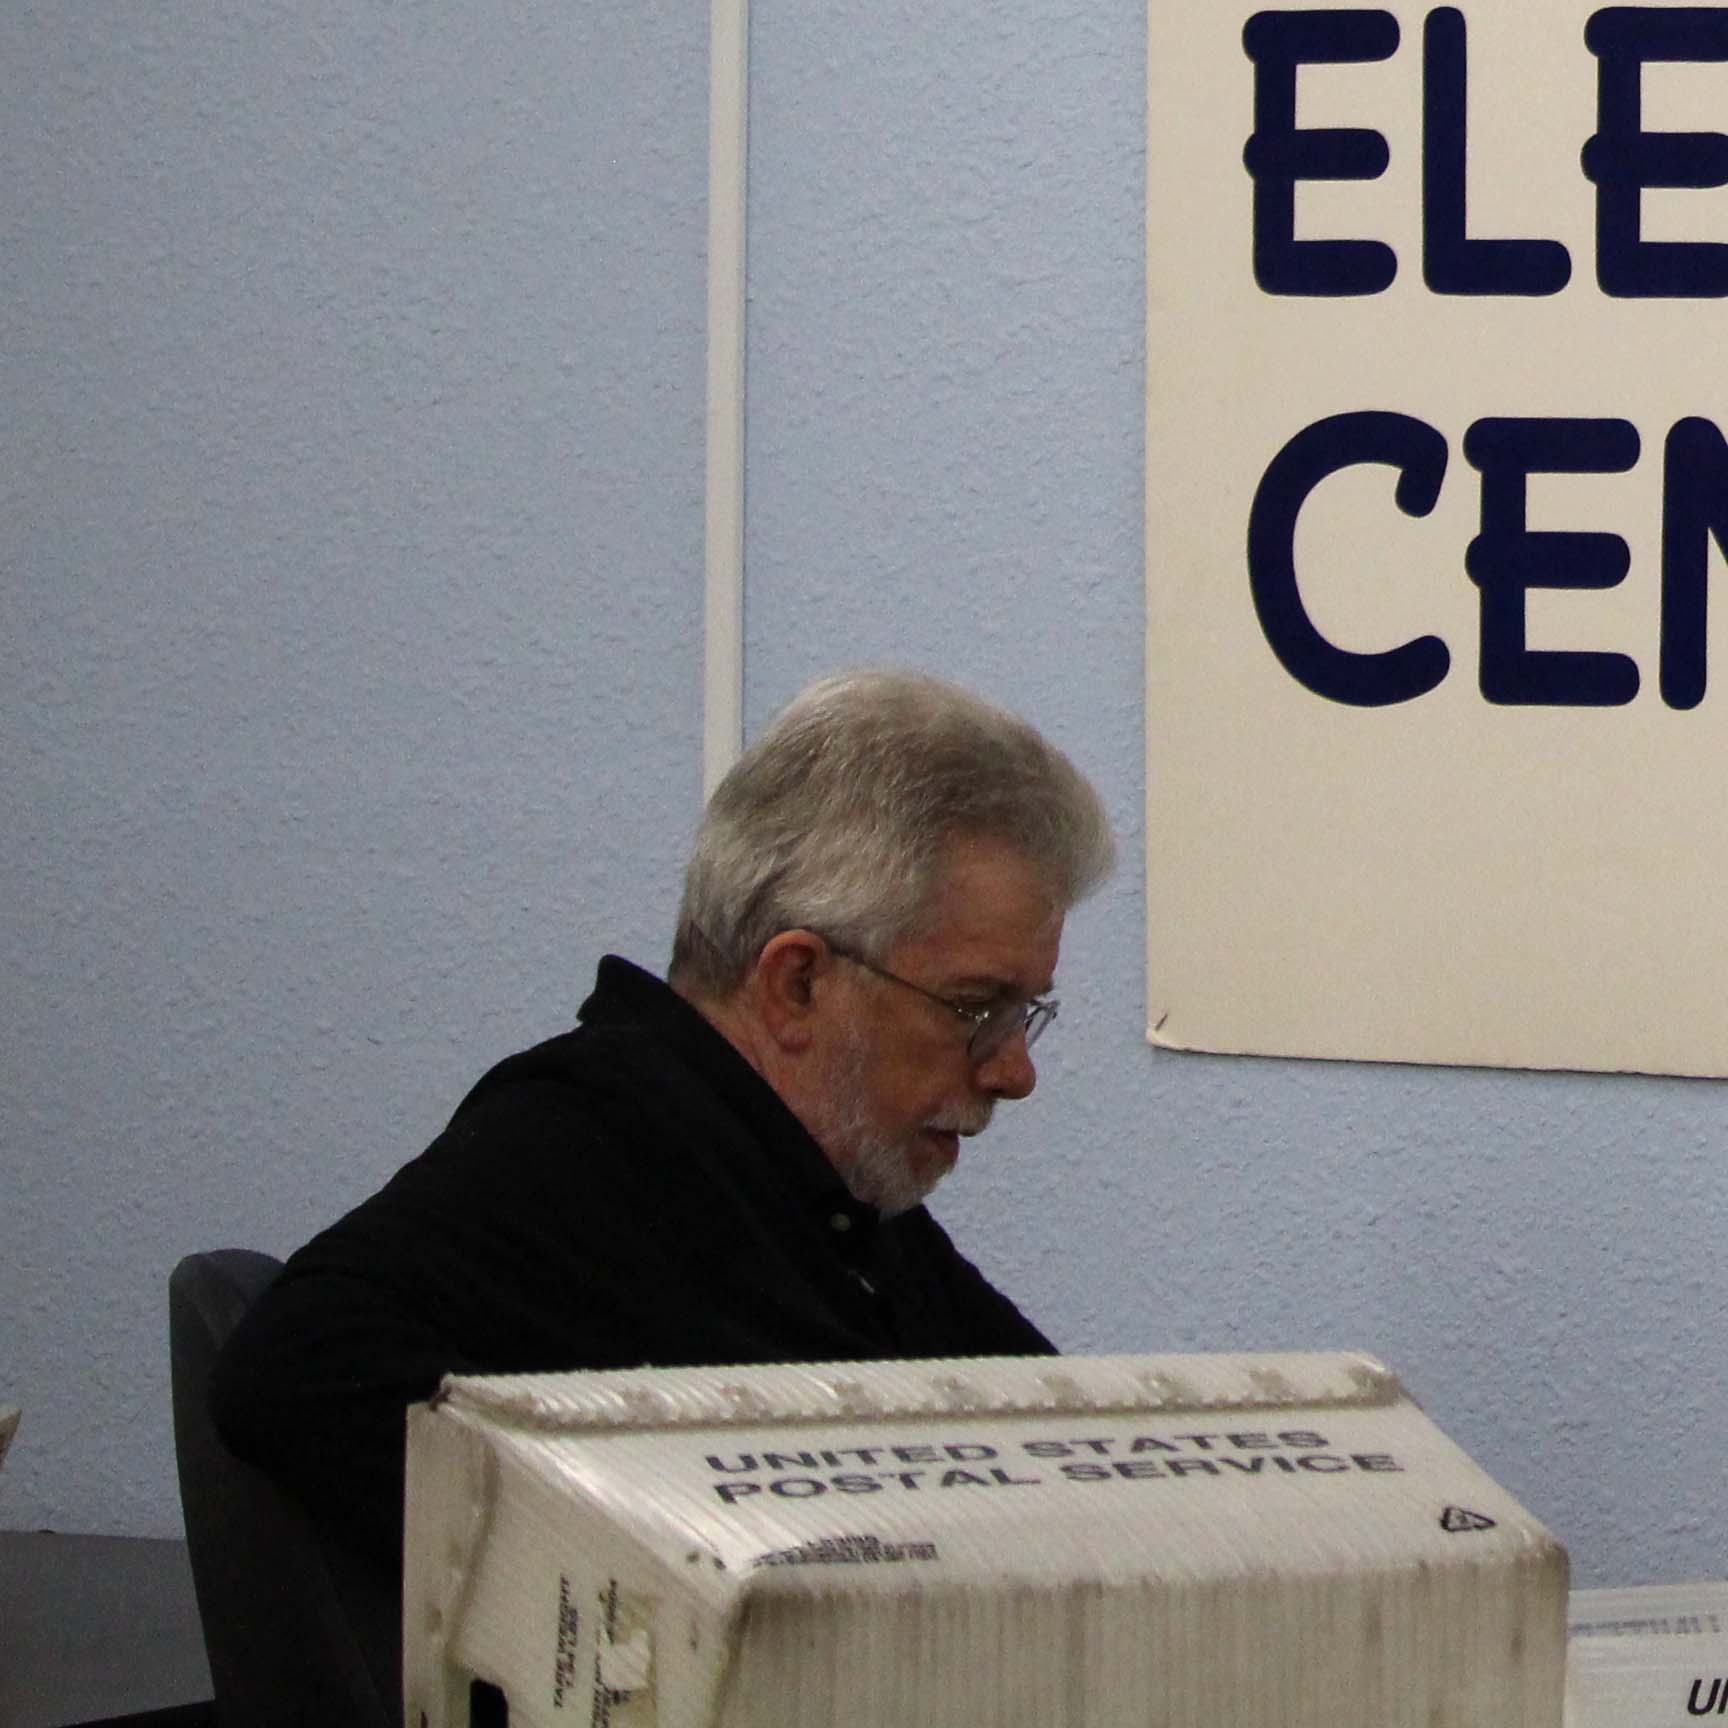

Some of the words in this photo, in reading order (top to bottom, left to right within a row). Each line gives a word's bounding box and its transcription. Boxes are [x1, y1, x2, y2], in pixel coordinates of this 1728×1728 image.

[705, 1440, 999, 1473] UNITED
[1021, 1429, 1331, 1459] STATES
[713, 1468, 1043, 1505] POSTAL
[1057, 1453, 1406, 1483] SERVICE
